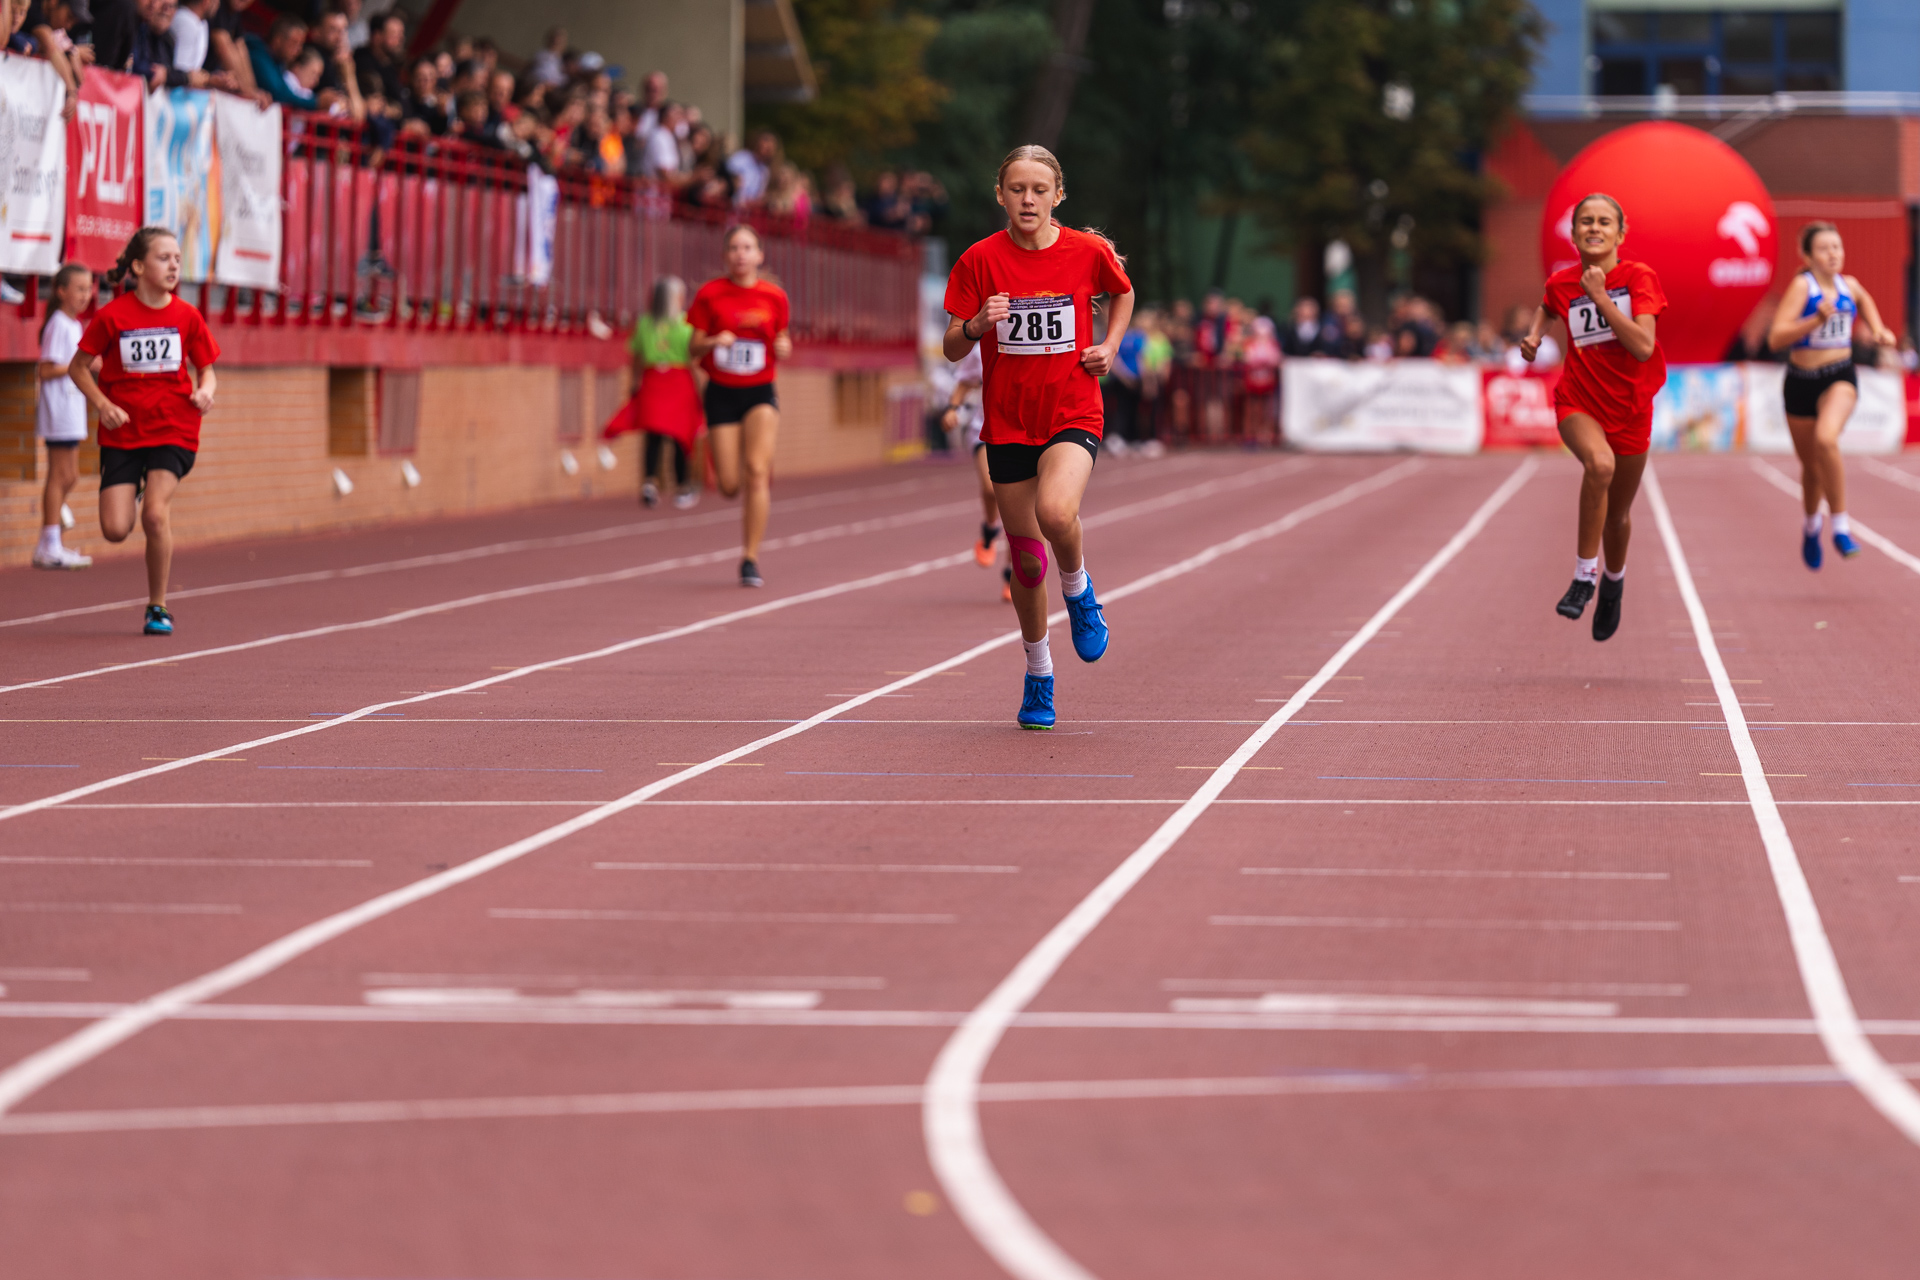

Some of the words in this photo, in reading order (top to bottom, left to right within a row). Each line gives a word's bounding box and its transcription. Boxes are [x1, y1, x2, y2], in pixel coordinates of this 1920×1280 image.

[77, 100, 136, 207] PZLA
[1008, 311, 1062, 341] 285
[1580, 300, 1617, 333] 28
[131, 339, 172, 361] 332
